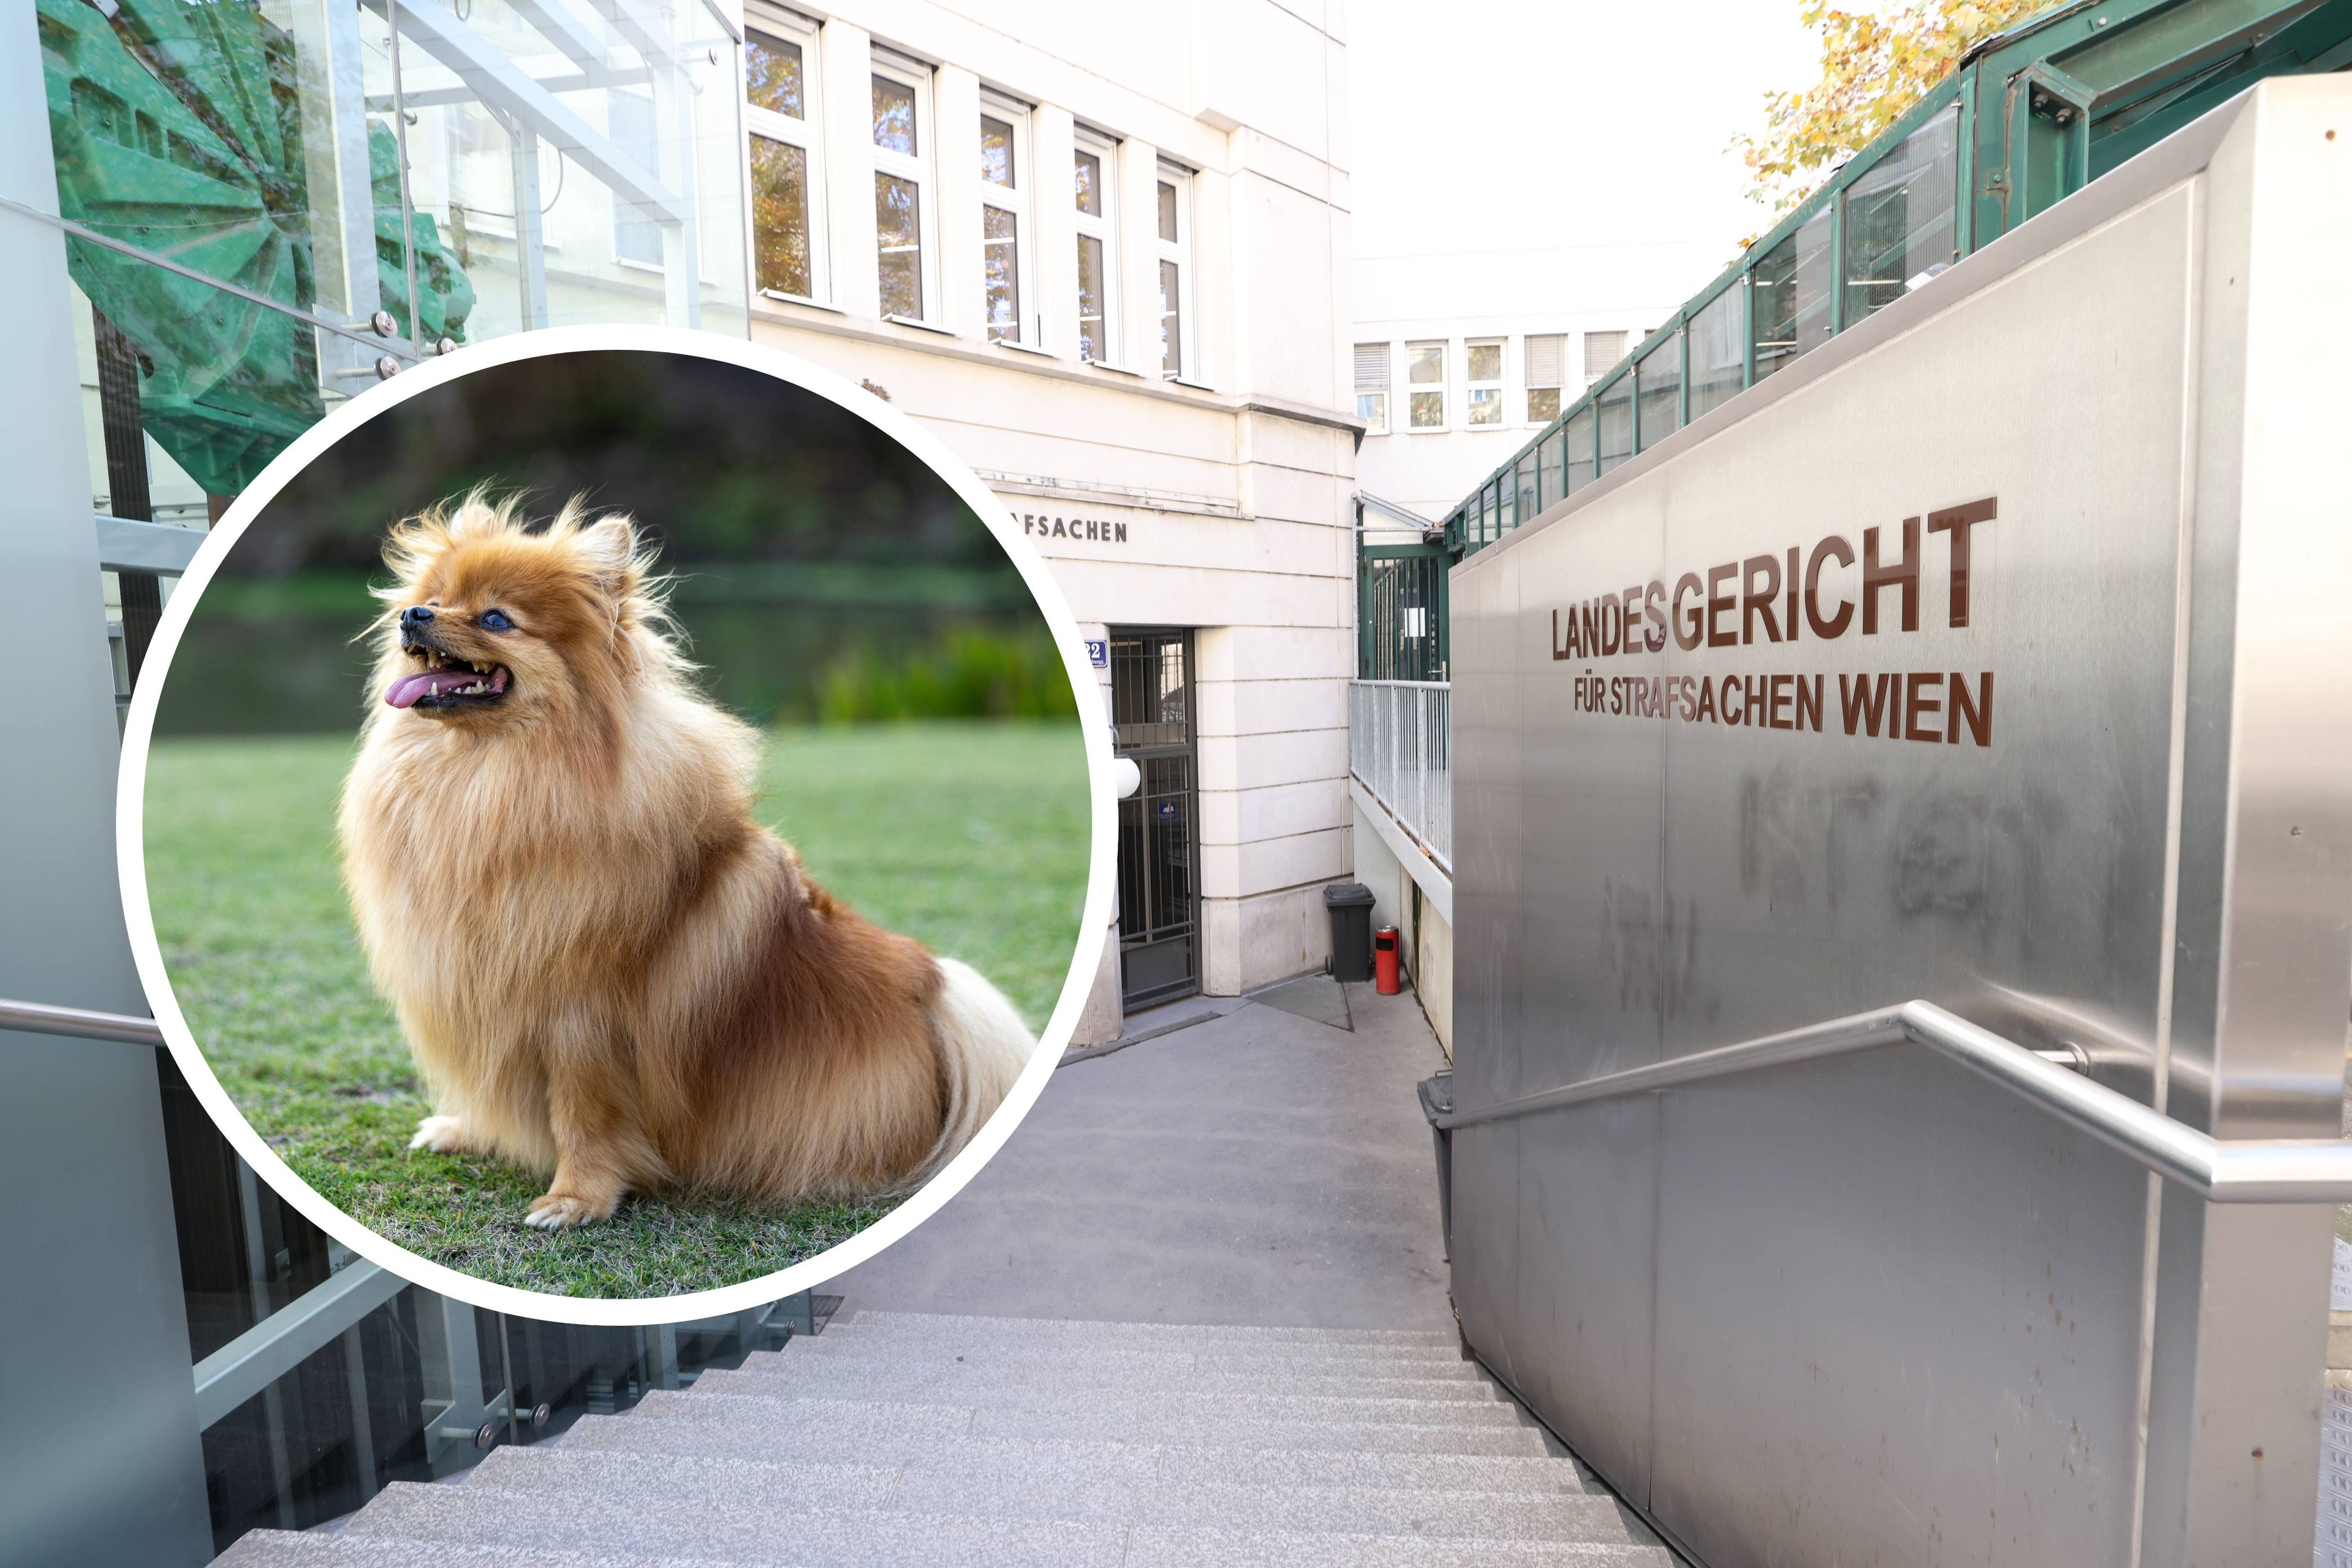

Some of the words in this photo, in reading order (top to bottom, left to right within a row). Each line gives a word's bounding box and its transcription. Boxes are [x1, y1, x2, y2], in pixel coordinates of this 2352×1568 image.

[1010, 513, 1127, 542] FSACHEN
[1552, 497, 1997, 660] LANDESGERICHT
[1574, 668, 1606, 713] FÜR
[1611, 674, 1824, 732] STRAFSACHEN
[1840, 671, 1994, 747] WIEN
